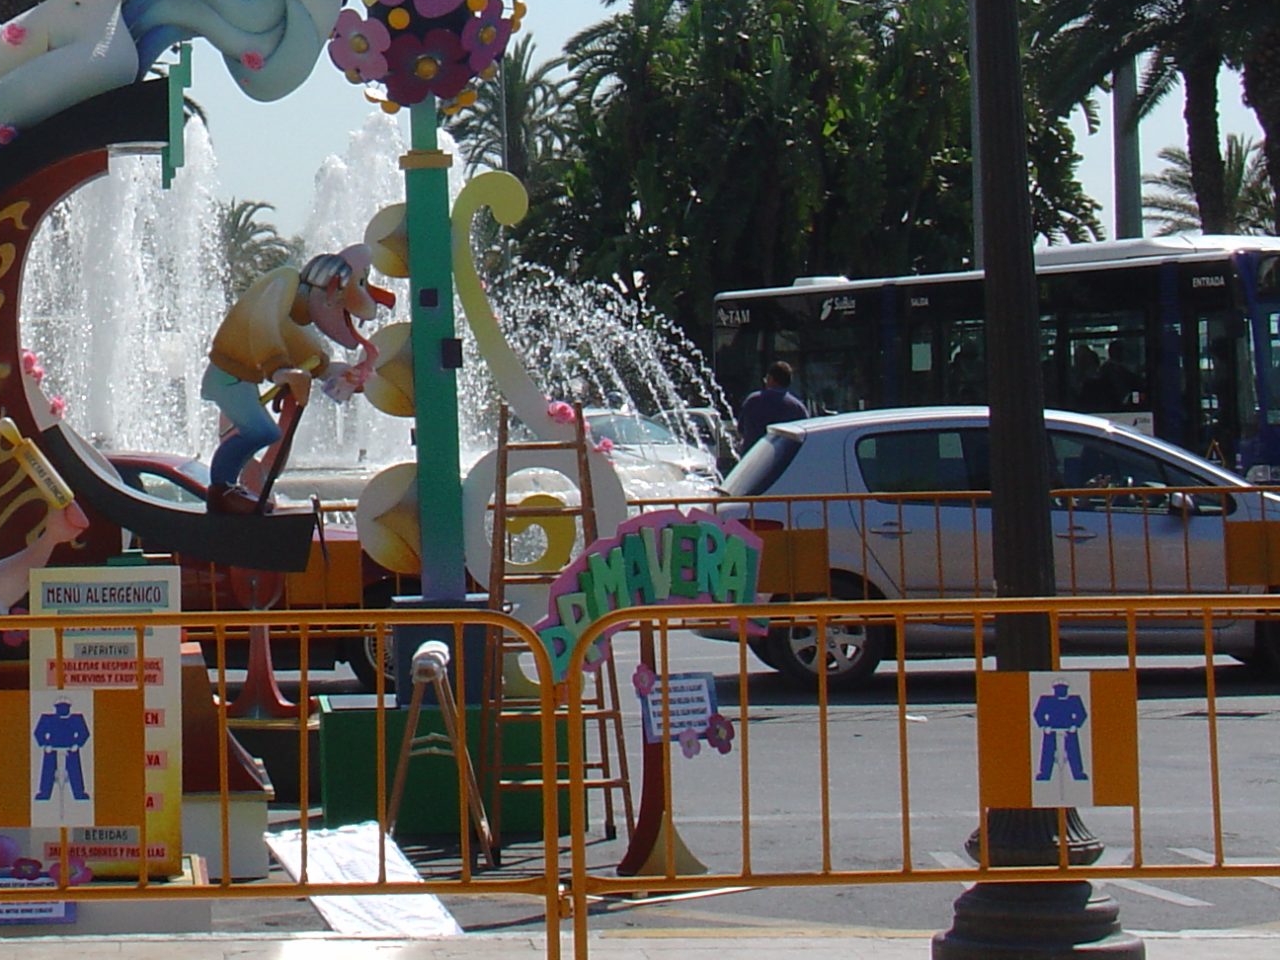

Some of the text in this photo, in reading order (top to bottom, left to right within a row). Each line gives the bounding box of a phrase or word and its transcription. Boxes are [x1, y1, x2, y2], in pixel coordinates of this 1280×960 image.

[1192, 276, 1225, 288] ENTRADA
[729, 309, 750, 324] TAM
[81, 645, 129, 656] APERITIVO
[49, 661, 100, 671] POBLEMAS
[84, 829, 129, 841] BEBIDAS
[125, 847, 165, 858] PASLLAS
